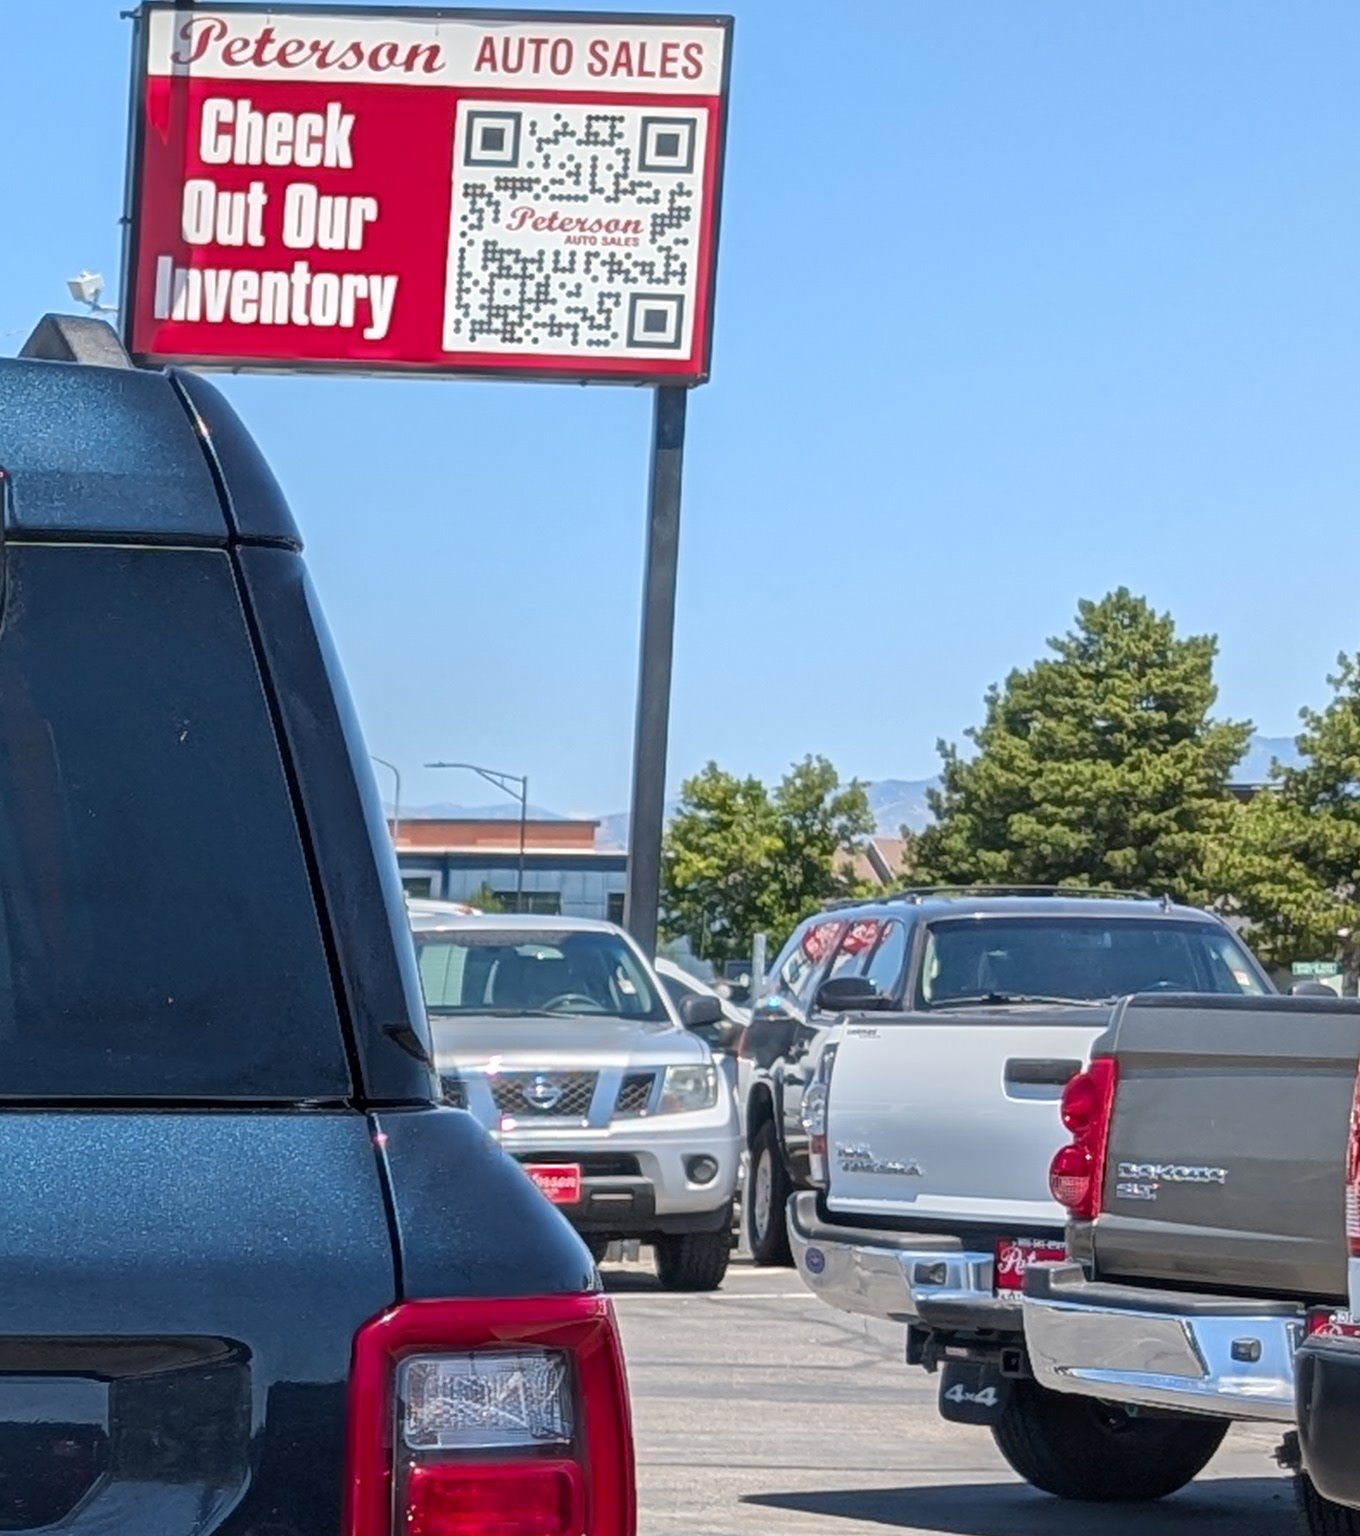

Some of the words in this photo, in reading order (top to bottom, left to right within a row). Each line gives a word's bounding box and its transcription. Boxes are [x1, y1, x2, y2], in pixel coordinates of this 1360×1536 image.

[171, 17, 446, 73] Peterson
[474, 36, 574, 76] AUTO
[586, 39, 704, 80] SALES
[199, 98, 356, 169] Check
[181, 179, 267, 249] Out
[281, 183, 379, 251] Our
[506, 206, 644, 234] Peterson
[564, 235, 597, 246] AUTO
[601, 236, 640, 247] SALES
[153, 256, 399, 340] Inventory
[943, 1383, 998, 1407] 4x4
